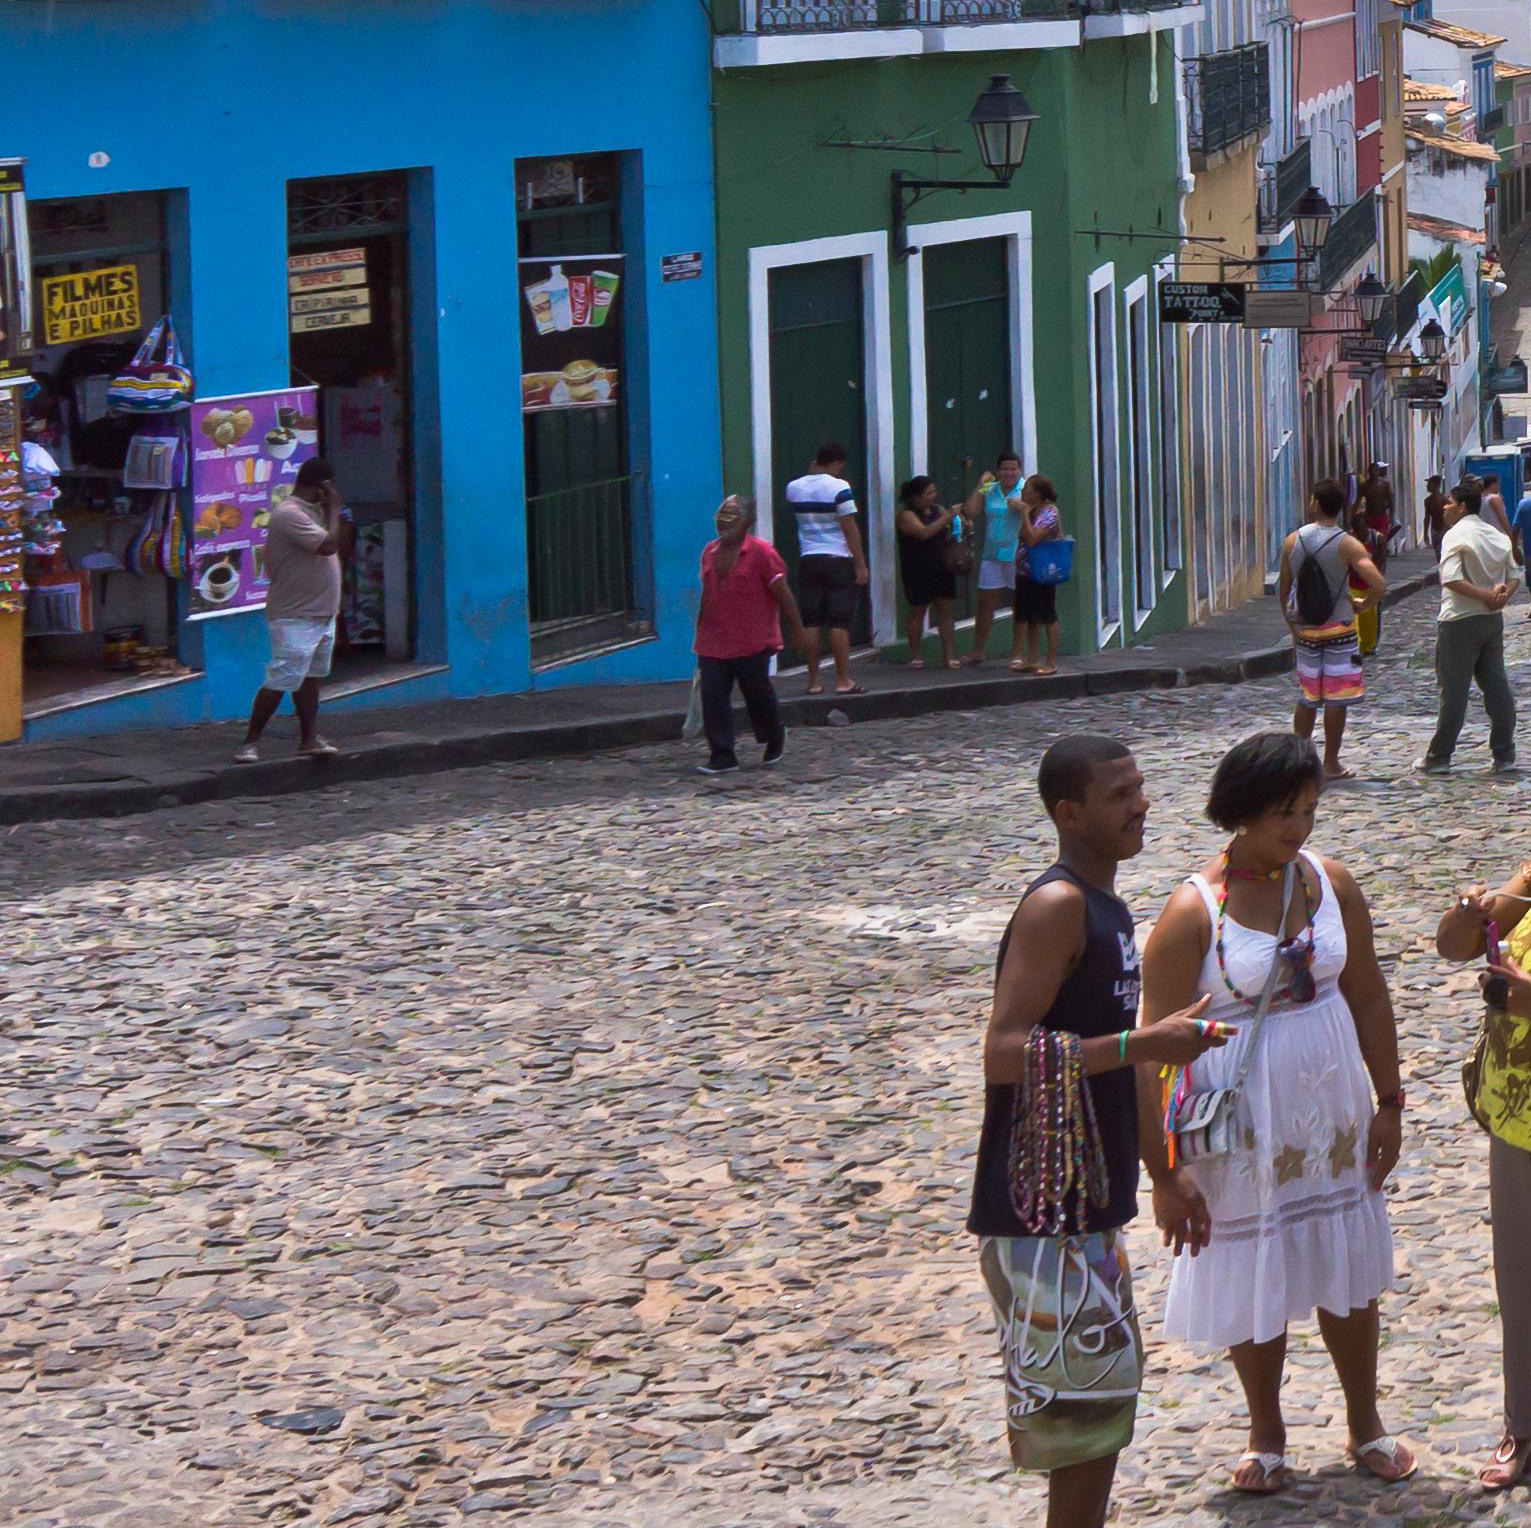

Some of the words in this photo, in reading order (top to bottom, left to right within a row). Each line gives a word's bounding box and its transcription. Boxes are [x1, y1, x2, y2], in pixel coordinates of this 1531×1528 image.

[47, 271, 134, 305] FILMES
[1164, 284, 1208, 295] CUSTOM
[1164, 296, 1221, 309] TATTOO
[50, 323, 61, 341] E
[69, 311, 138, 332] PILHAS
